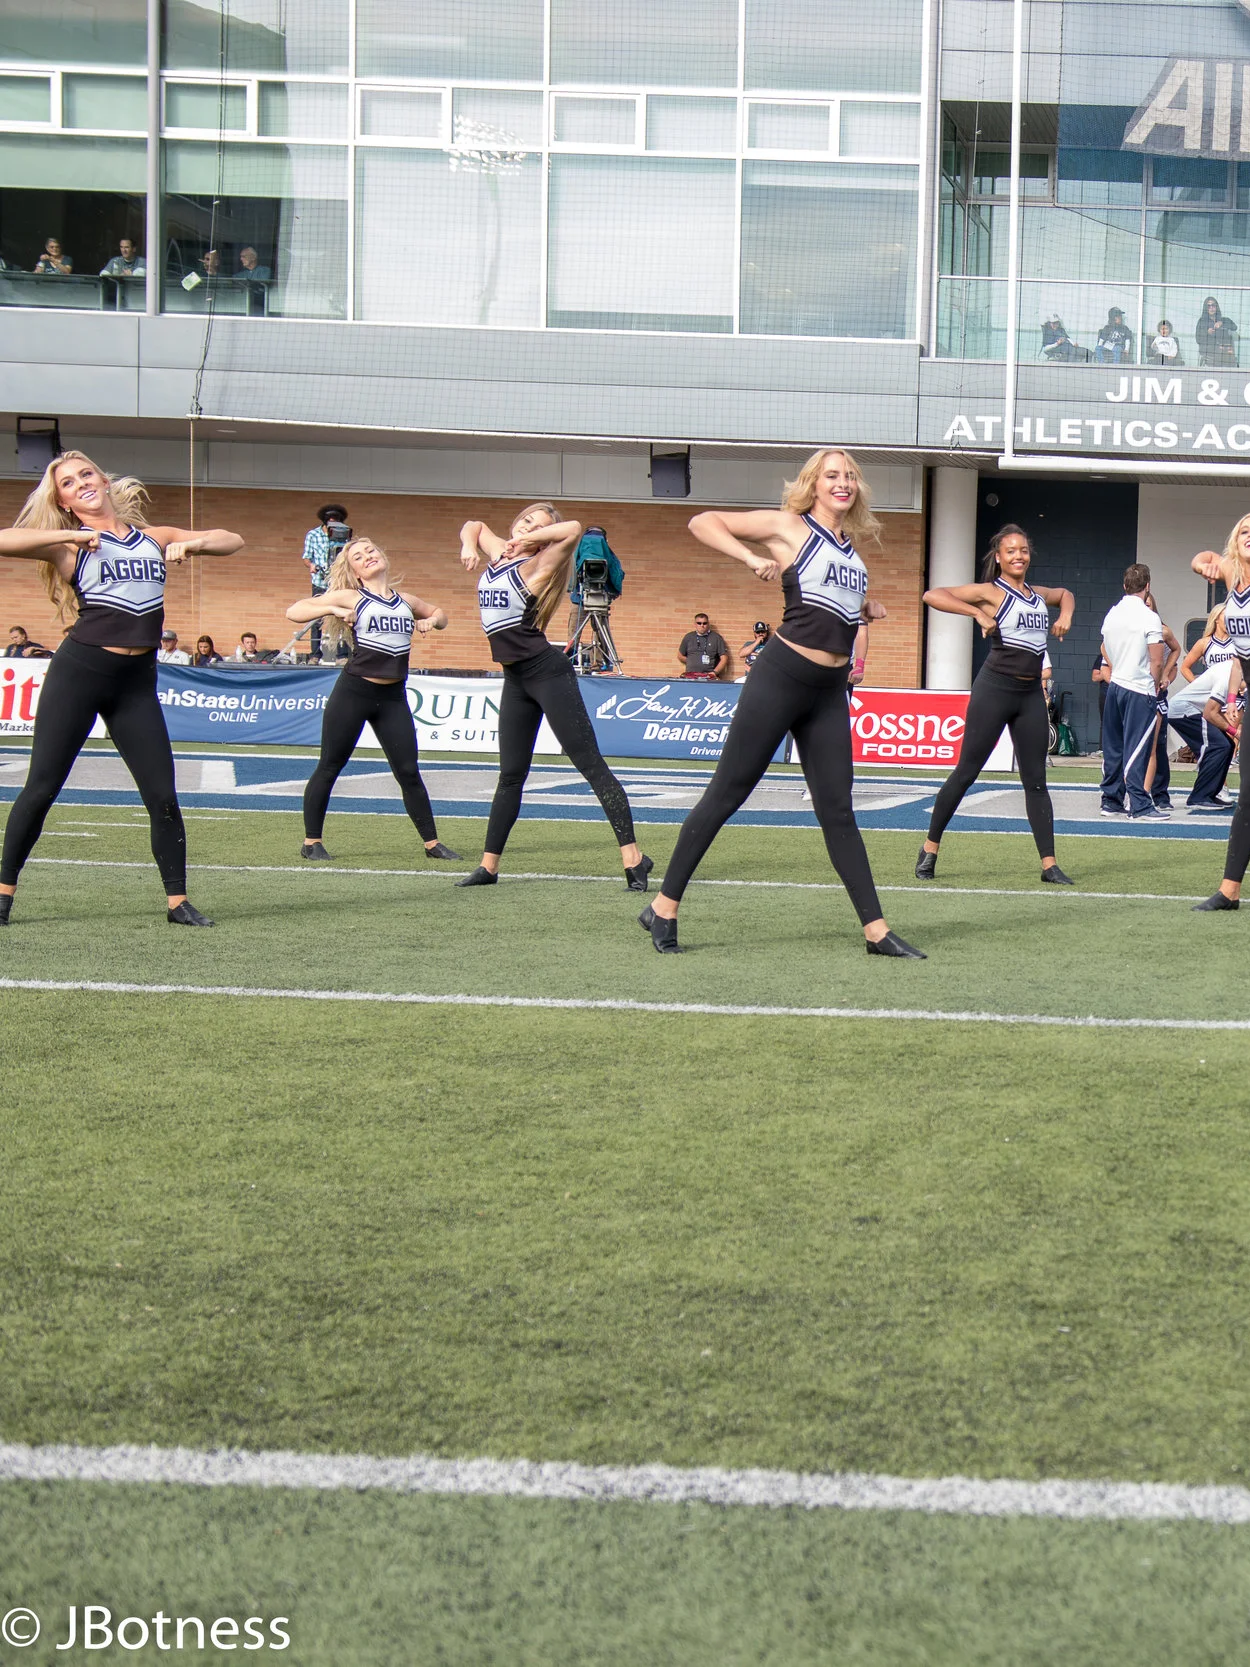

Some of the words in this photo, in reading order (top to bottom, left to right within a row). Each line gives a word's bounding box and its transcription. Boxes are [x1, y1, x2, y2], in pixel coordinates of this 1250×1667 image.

[1105, 376, 1183, 405] JIM
[1197, 378, 1230, 407] &
[821, 562, 868, 593] AGGIE
[478, 589, 510, 608] GGIES
[1016, 612, 1049, 630] AGGIE
[208, 711, 259, 723] ONLINE
[451, 730, 500, 742] SUIT
[861, 743, 954, 759] FOODS
